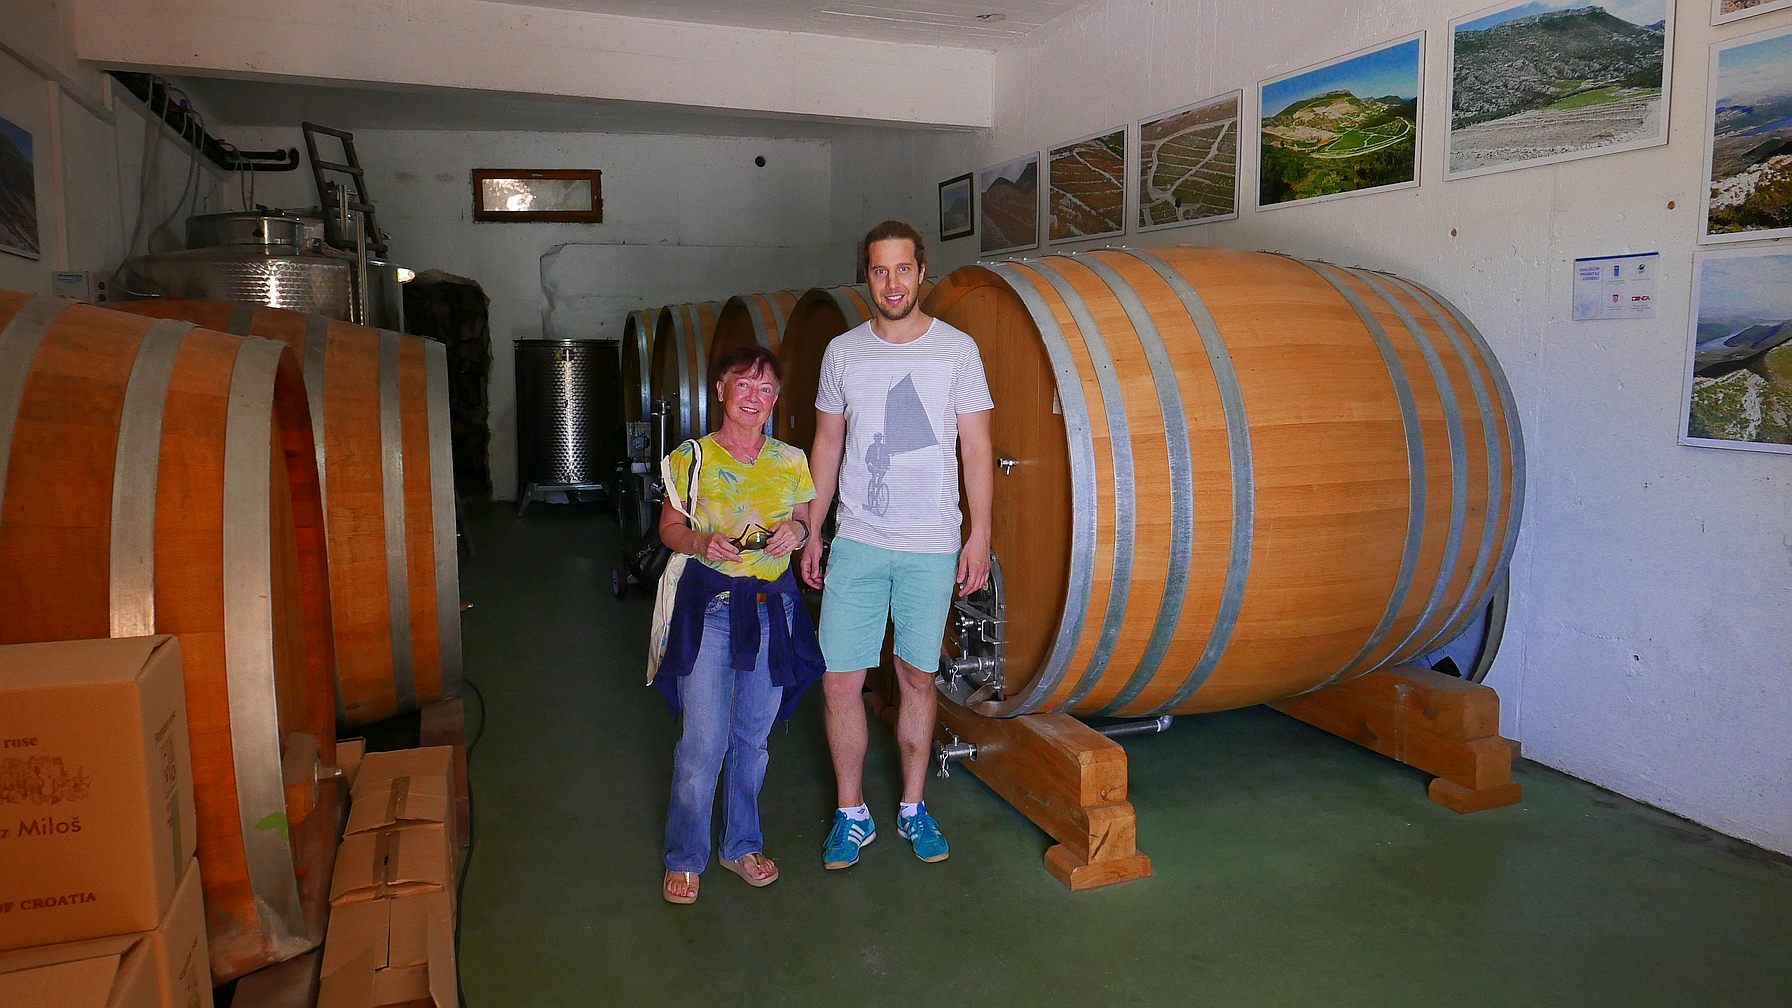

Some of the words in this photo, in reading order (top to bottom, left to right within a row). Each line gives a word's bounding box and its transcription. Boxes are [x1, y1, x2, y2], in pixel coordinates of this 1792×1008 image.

[3, 737, 38, 749] rose
[18, 816, 82, 838] Miloš
[20, 892, 97, 911] CROATIA
